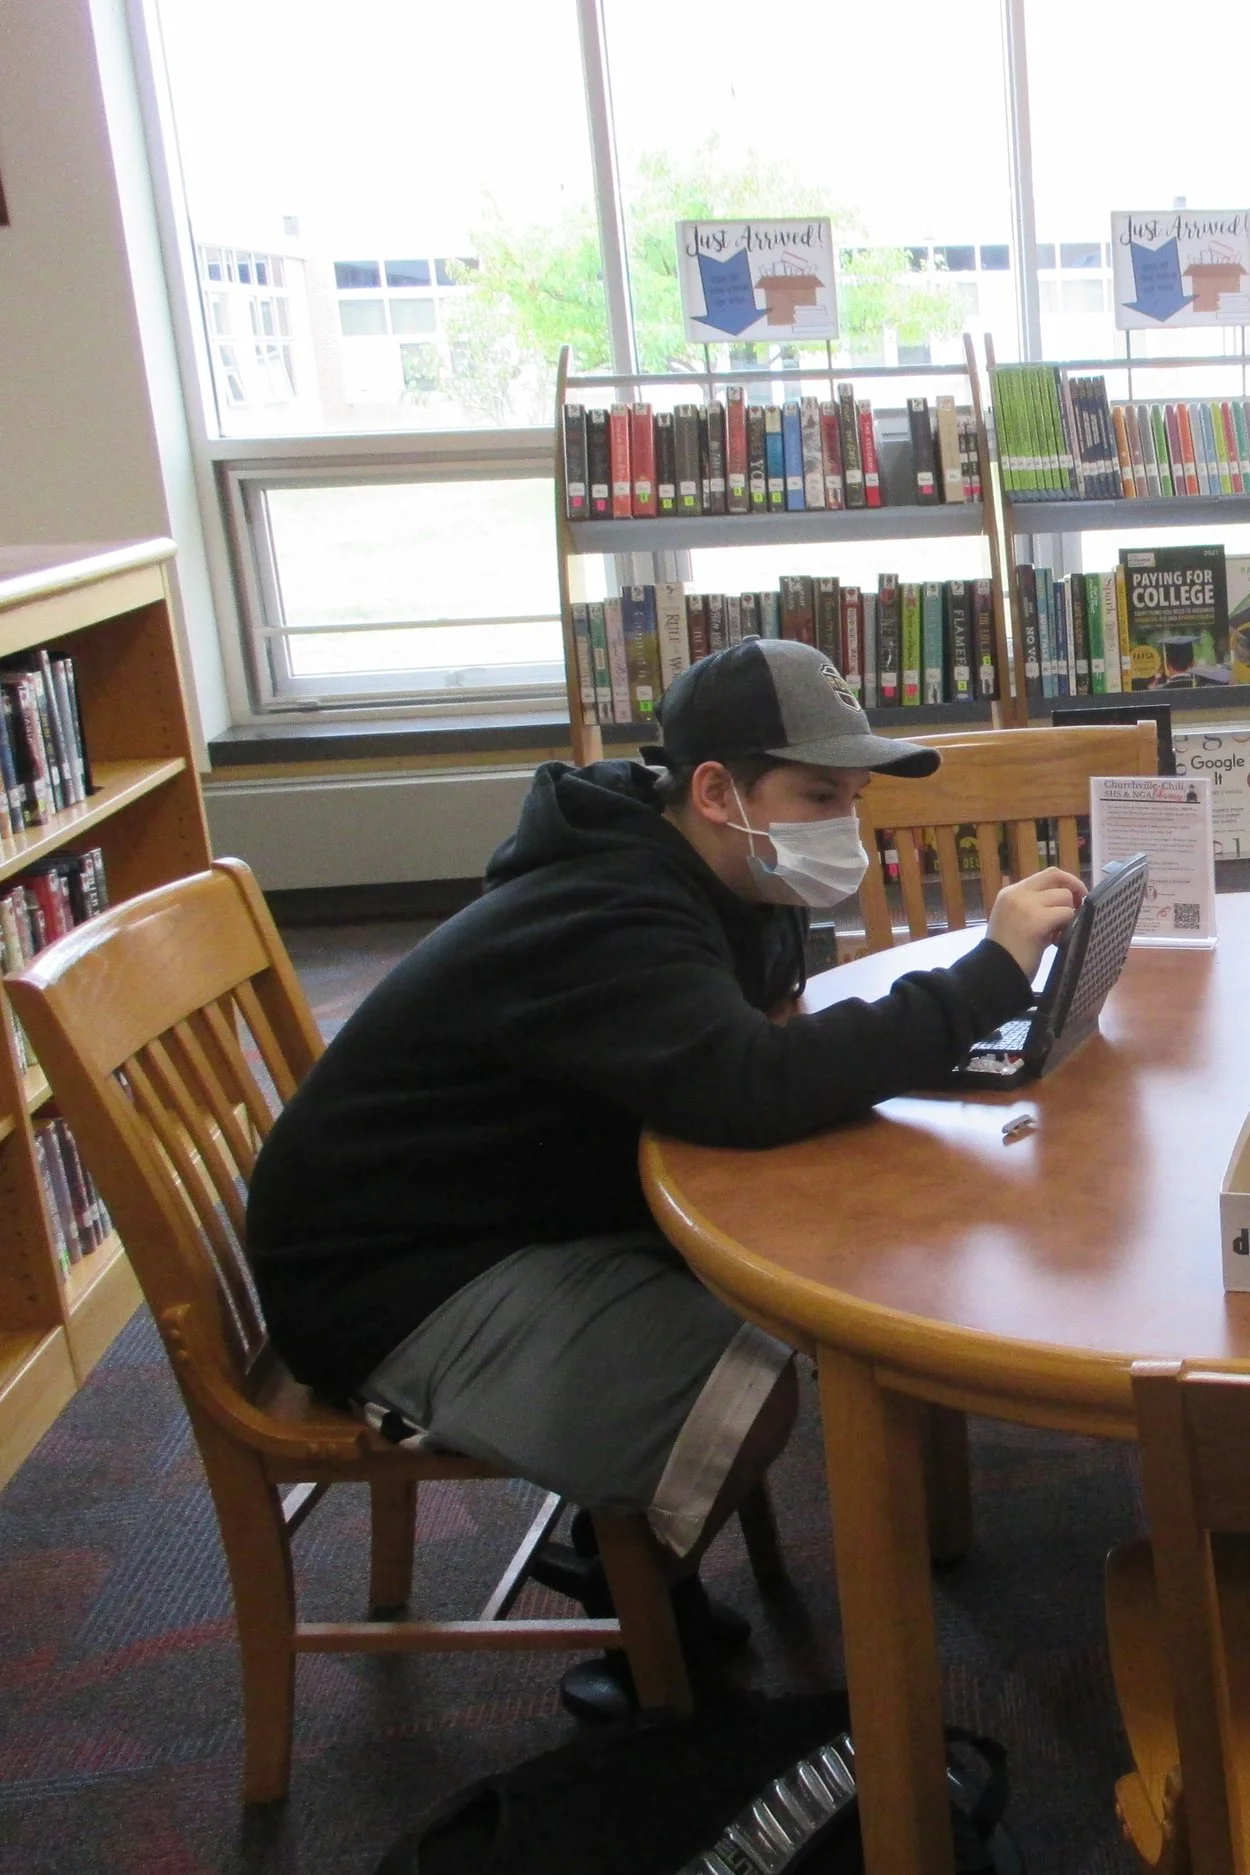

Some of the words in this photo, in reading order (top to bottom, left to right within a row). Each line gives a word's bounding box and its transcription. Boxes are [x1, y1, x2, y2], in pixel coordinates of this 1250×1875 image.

[686, 225, 727, 257] Just
[735, 223, 825, 252] Arrived!
[1120, 215, 1159, 246] Just
[1166, 213, 1250, 241] Arrived!
[1132, 570, 1183, 587] PAYING
[1186, 569, 1213, 584] FOR
[1132, 584, 1215, 608] COLLEGE
[951, 609, 967, 668] FLAMEF
[1190, 753, 1245, 771] Google
[1214, 771, 1223, 785] It
[1104, 790, 1122, 799] SHS
